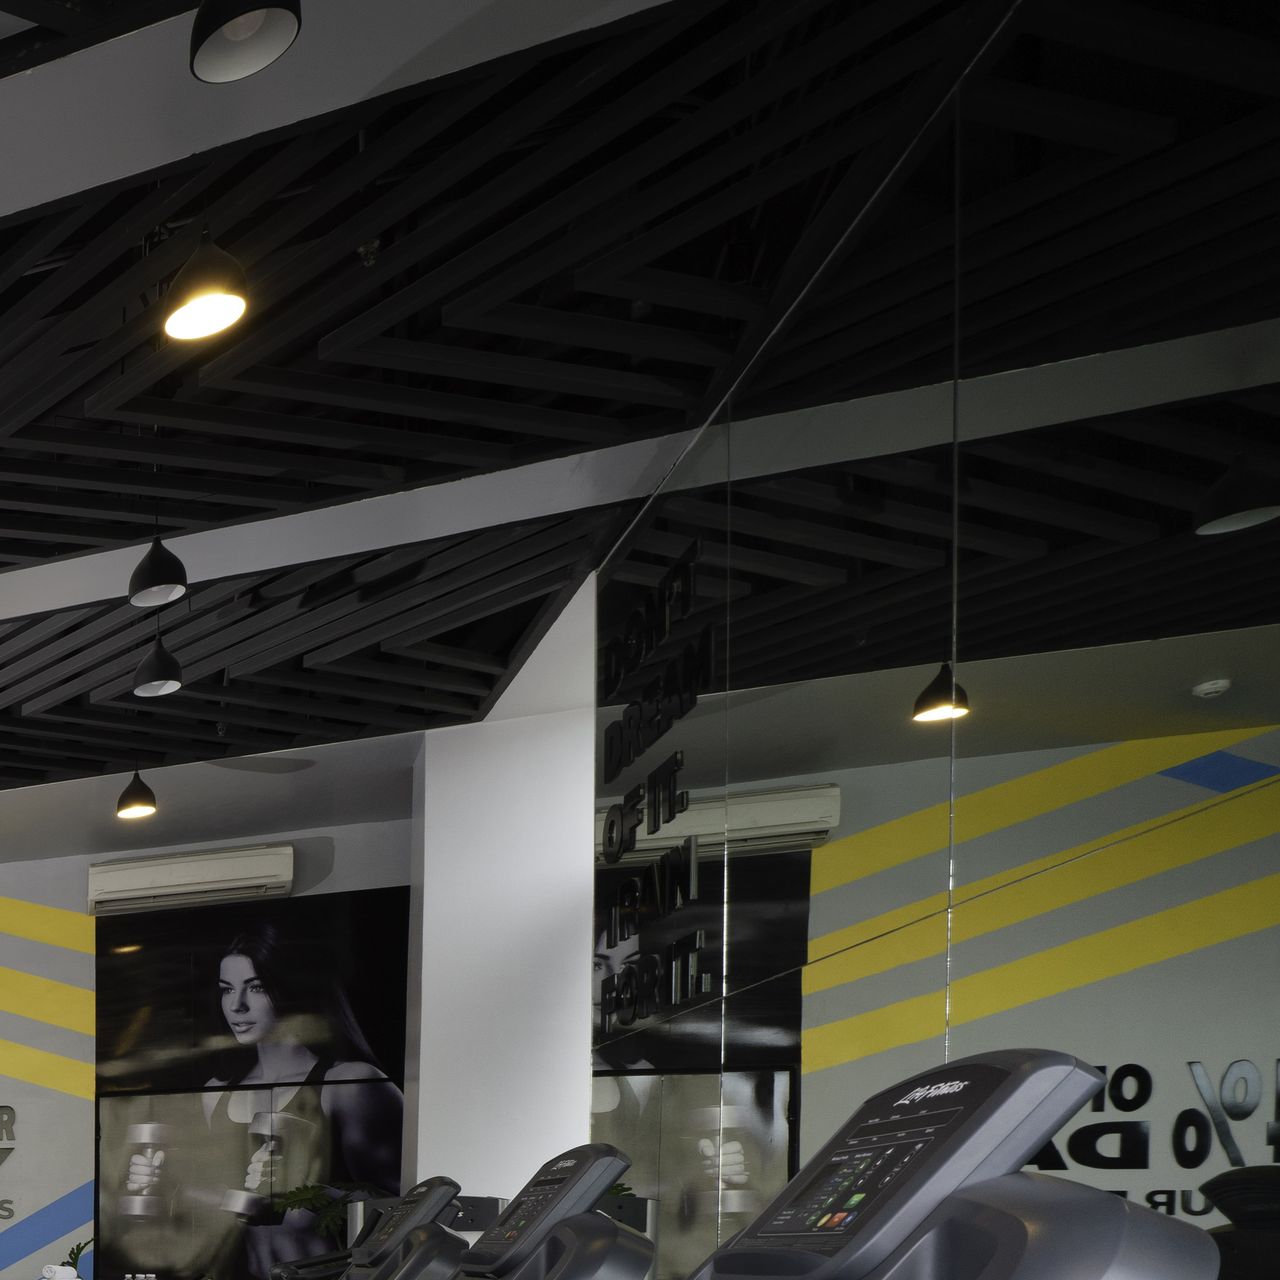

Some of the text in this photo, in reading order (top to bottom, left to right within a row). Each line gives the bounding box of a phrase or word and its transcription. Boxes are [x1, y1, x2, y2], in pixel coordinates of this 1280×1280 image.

[604, 621, 714, 784] DREAM
[603, 783, 646, 864] OF
[606, 835, 698, 949] TRAIN
[601, 953, 664, 1034] FOR
